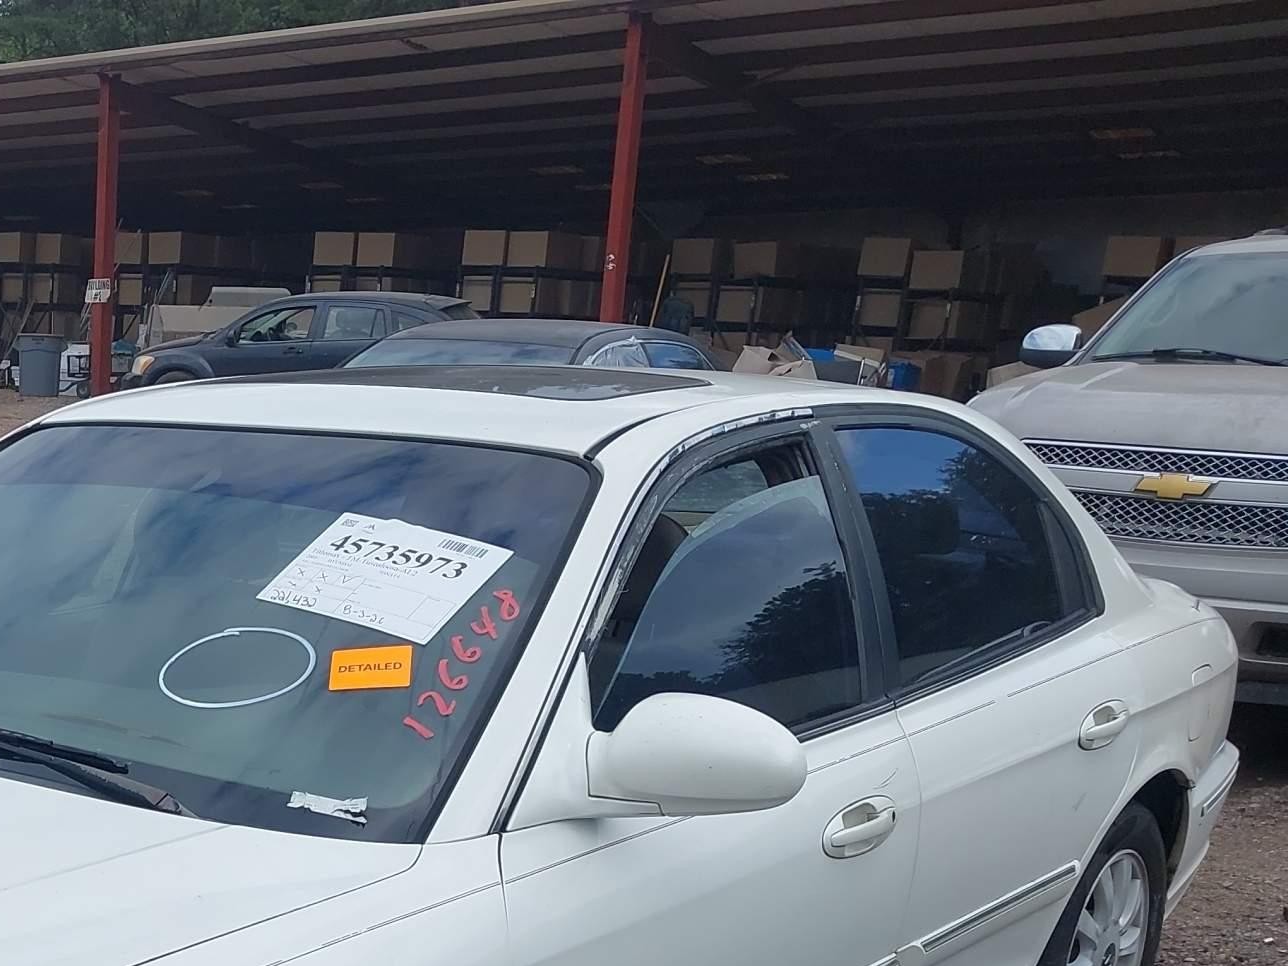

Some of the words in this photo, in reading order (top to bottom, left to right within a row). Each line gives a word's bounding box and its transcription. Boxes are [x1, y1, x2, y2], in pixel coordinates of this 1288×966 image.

[329, 534, 468, 579] 45735973
[338, 661, 403, 673] DETAILED
[403, 589, 521, 740] 126648
